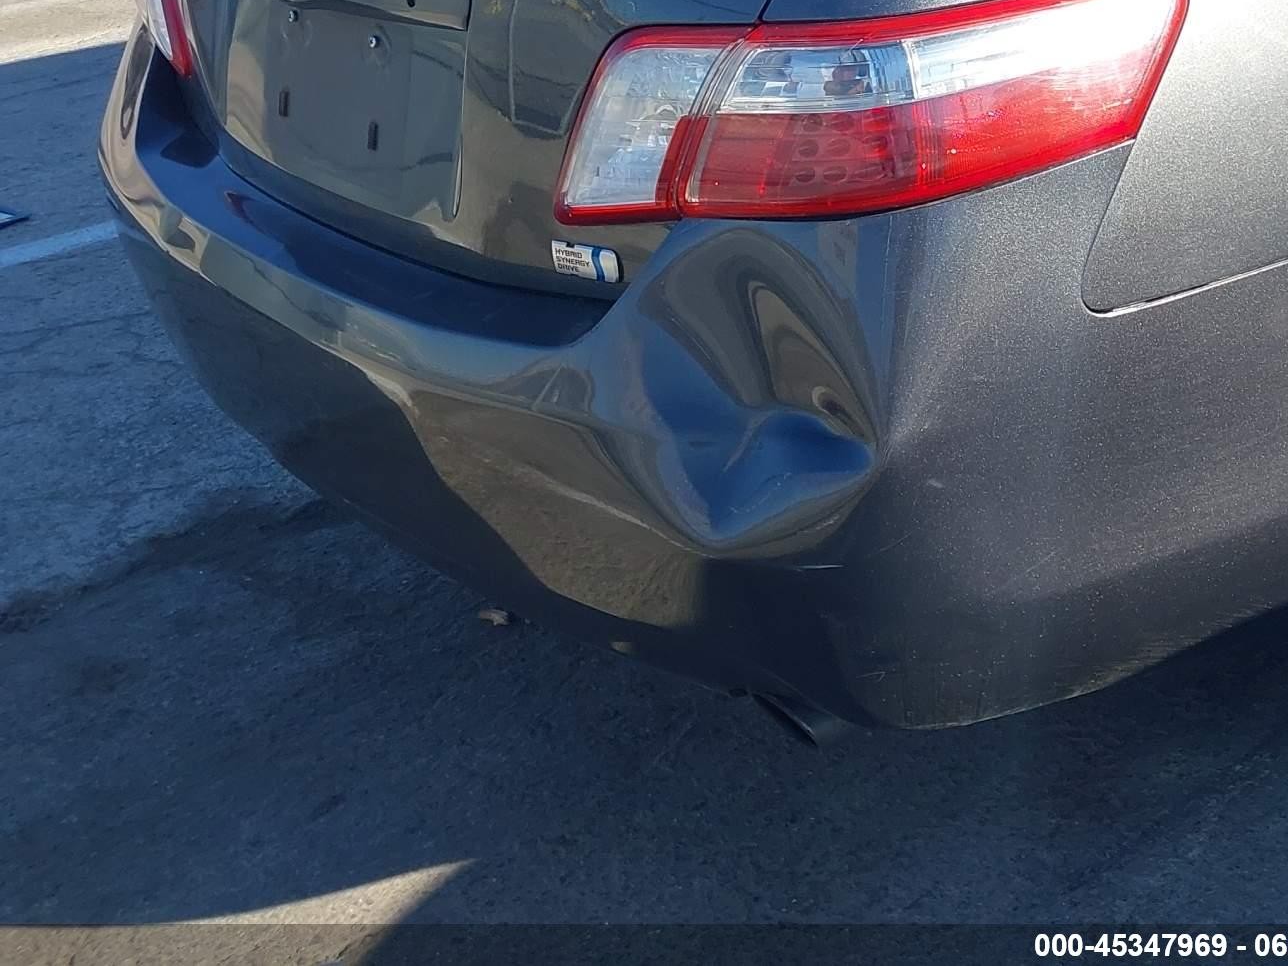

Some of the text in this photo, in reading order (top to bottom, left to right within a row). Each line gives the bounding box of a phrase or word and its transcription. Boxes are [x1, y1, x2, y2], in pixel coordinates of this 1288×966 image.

[554, 247, 583, 260] HYBRID
[555, 255, 590, 267] SYNERGY
[557, 263, 581, 273] DRIVE
